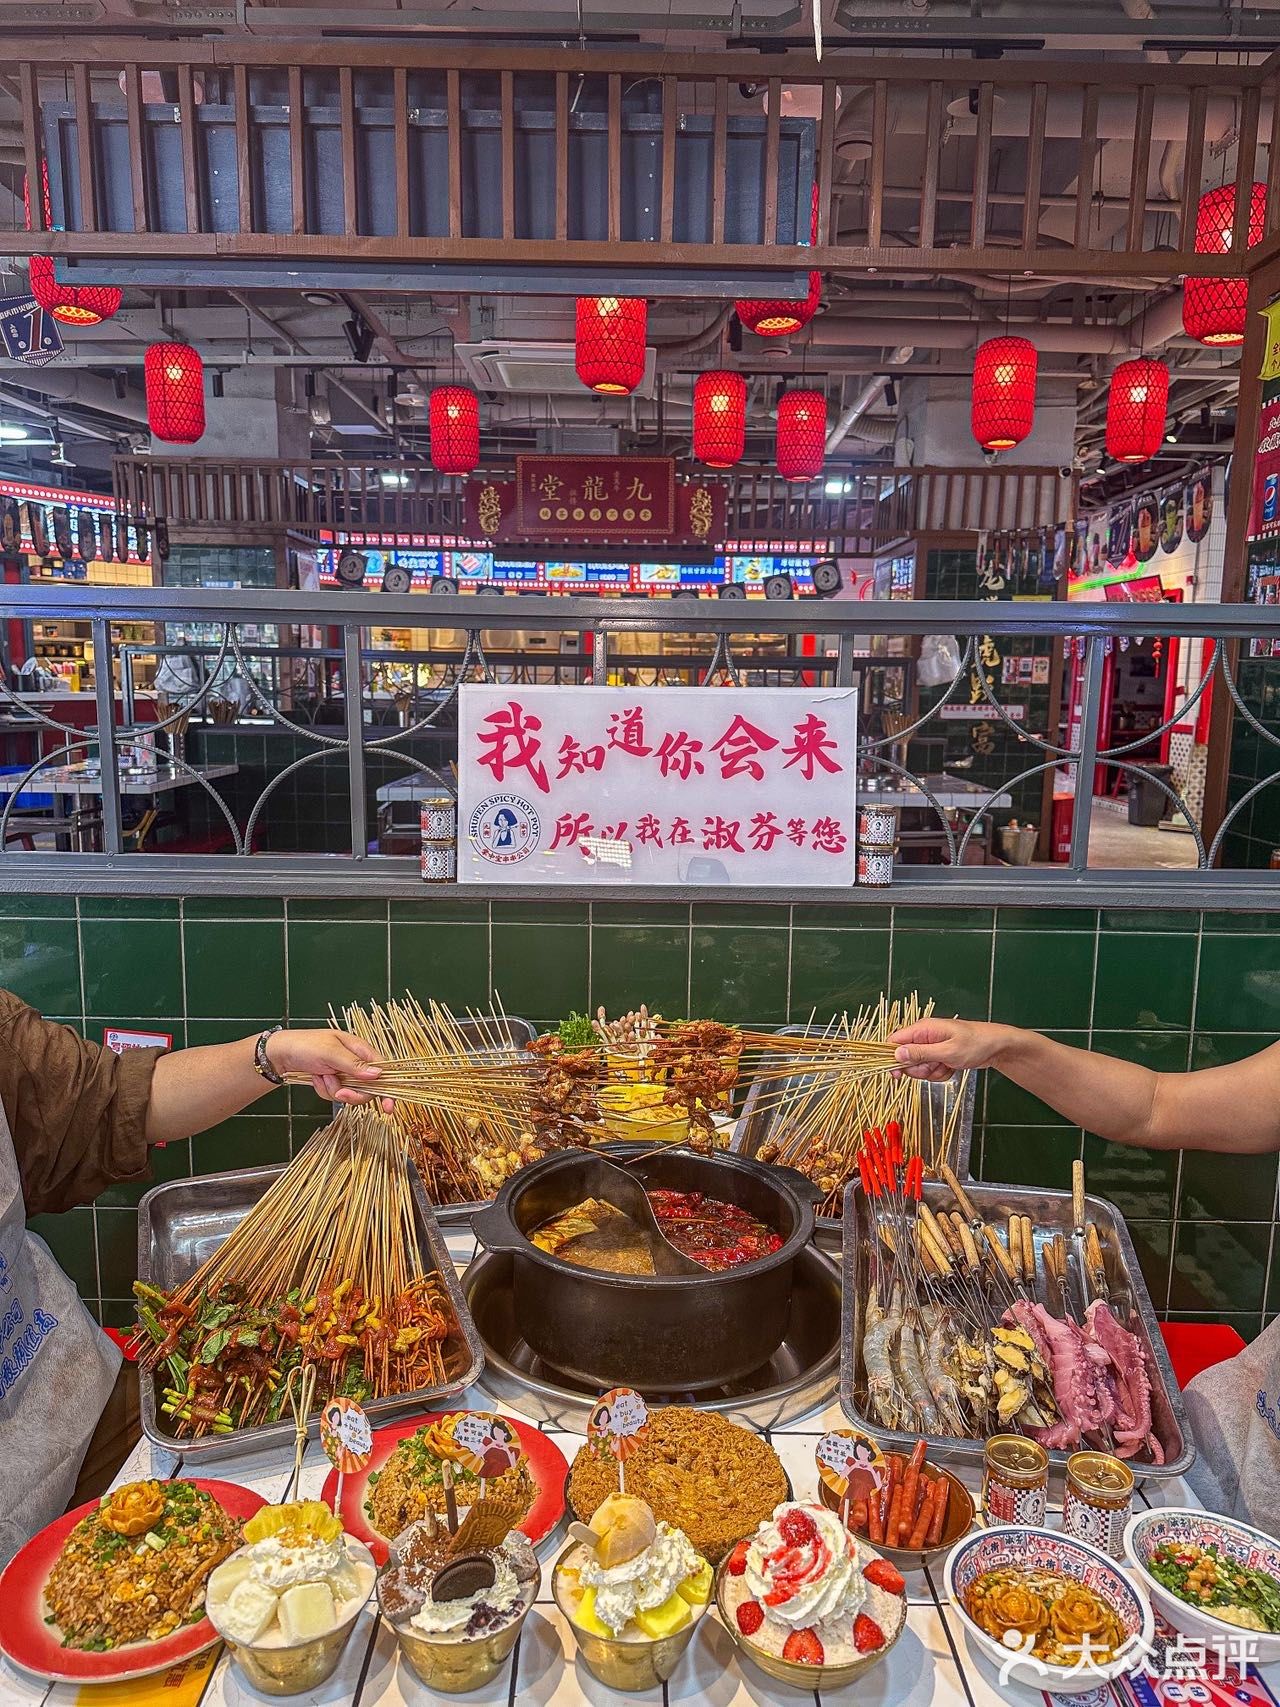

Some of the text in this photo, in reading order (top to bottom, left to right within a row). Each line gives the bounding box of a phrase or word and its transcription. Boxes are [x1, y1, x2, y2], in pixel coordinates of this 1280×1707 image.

[476, 701, 844, 793] 我知道你会来
[470, 802, 489, 838] SHUFEN
[488, 795, 516, 806] SPICY
[516, 799, 535, 816] HOT
[530, 816, 539, 838] POT
[549, 811, 848, 856] 所以我在淑芬等您
